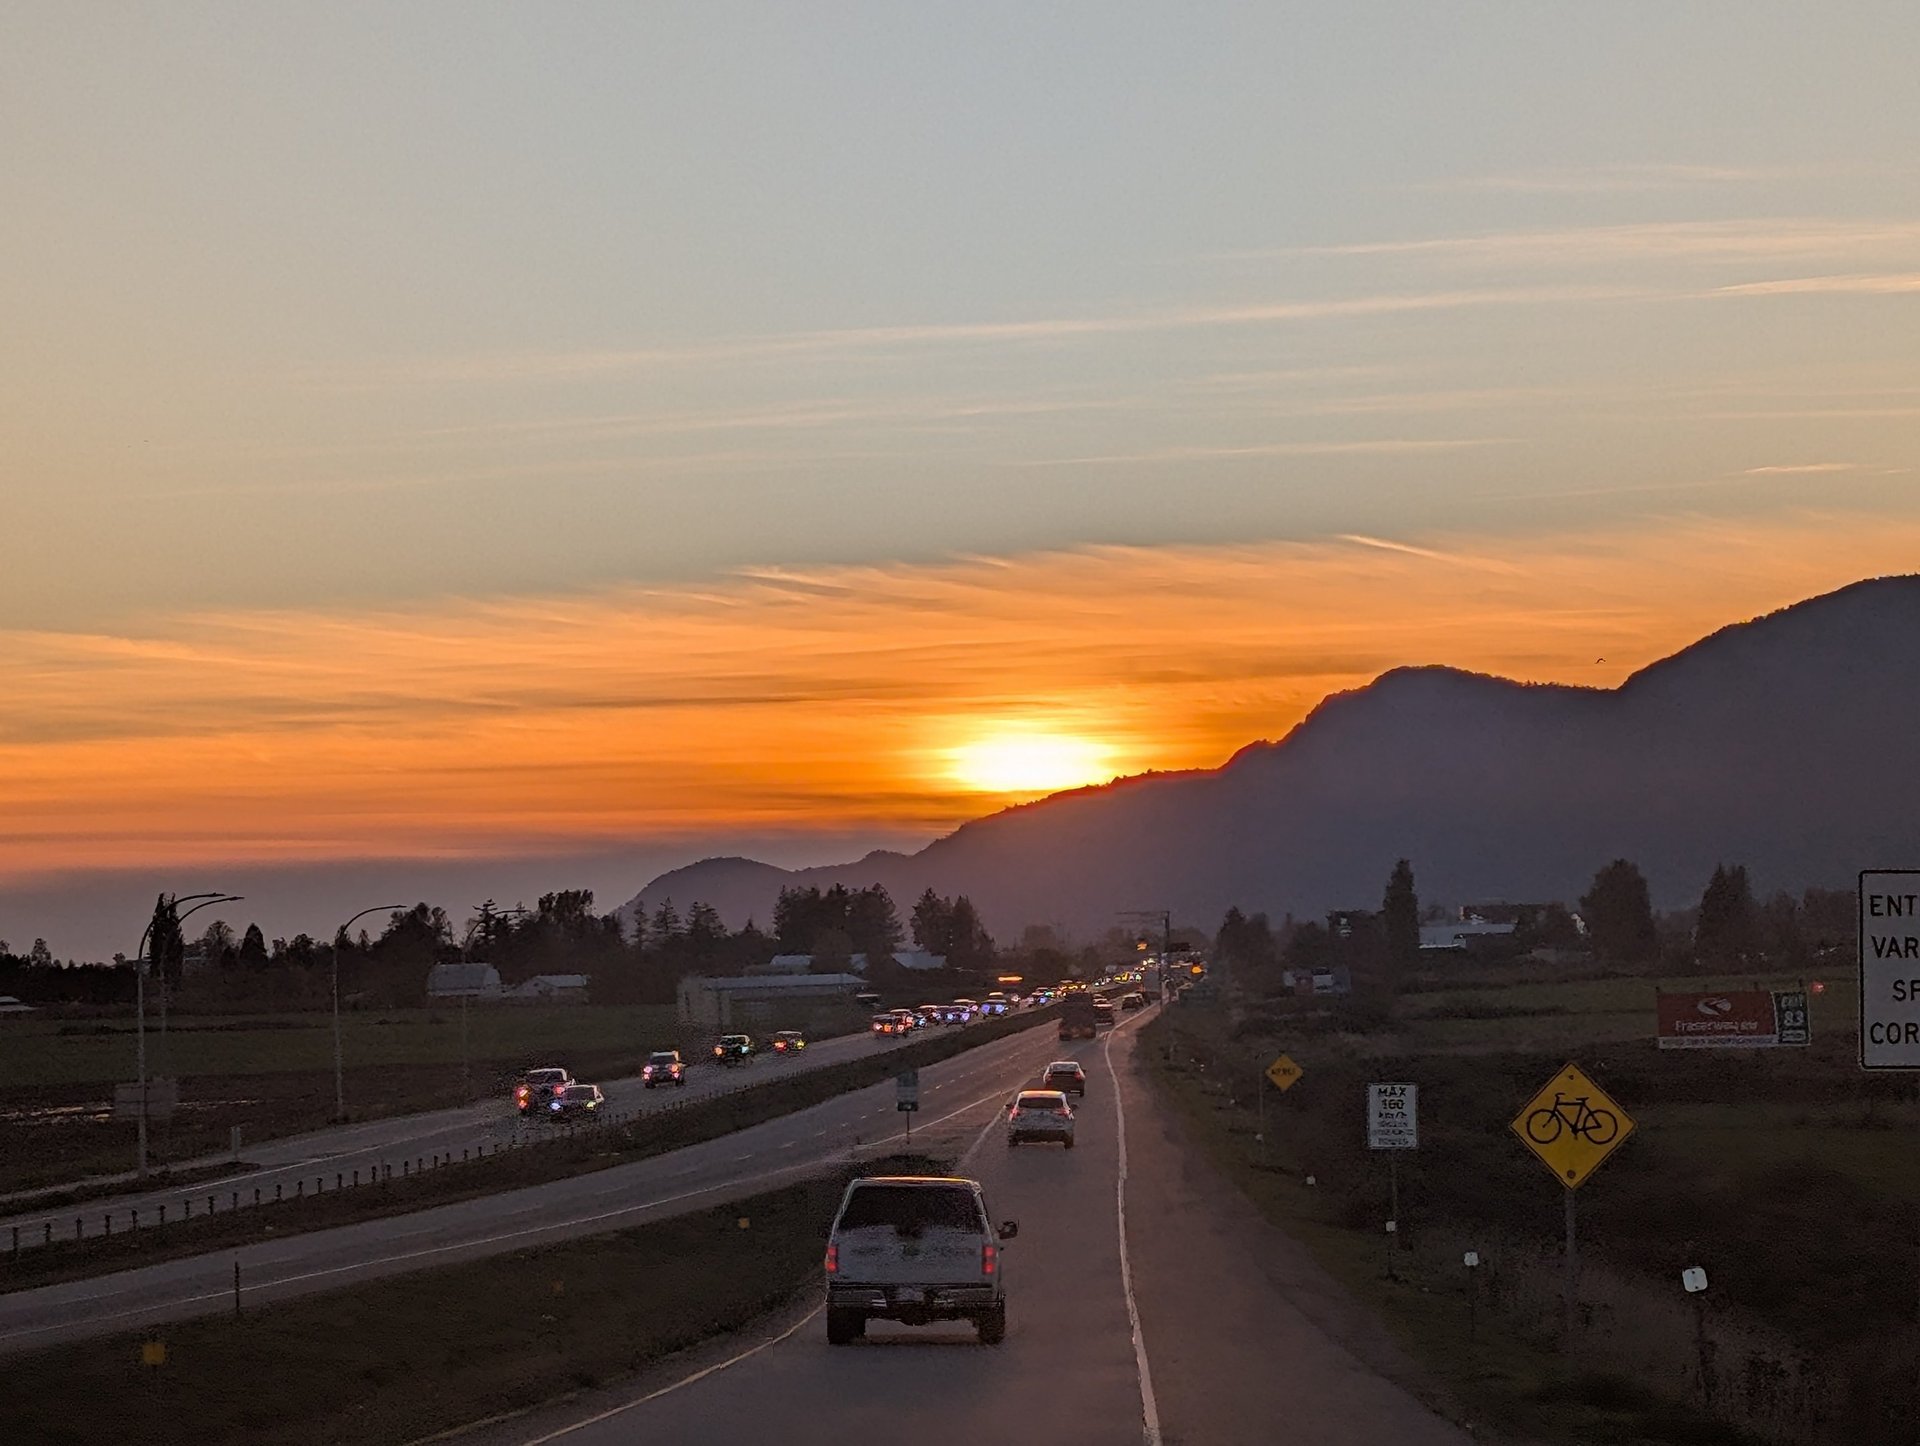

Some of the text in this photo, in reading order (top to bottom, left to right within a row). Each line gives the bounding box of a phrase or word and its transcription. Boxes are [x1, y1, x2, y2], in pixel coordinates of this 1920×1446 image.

[1870, 895, 1918, 917] ENT
[1870, 935, 1920, 959] VAR
[1870, 1021, 1920, 1045] COR
